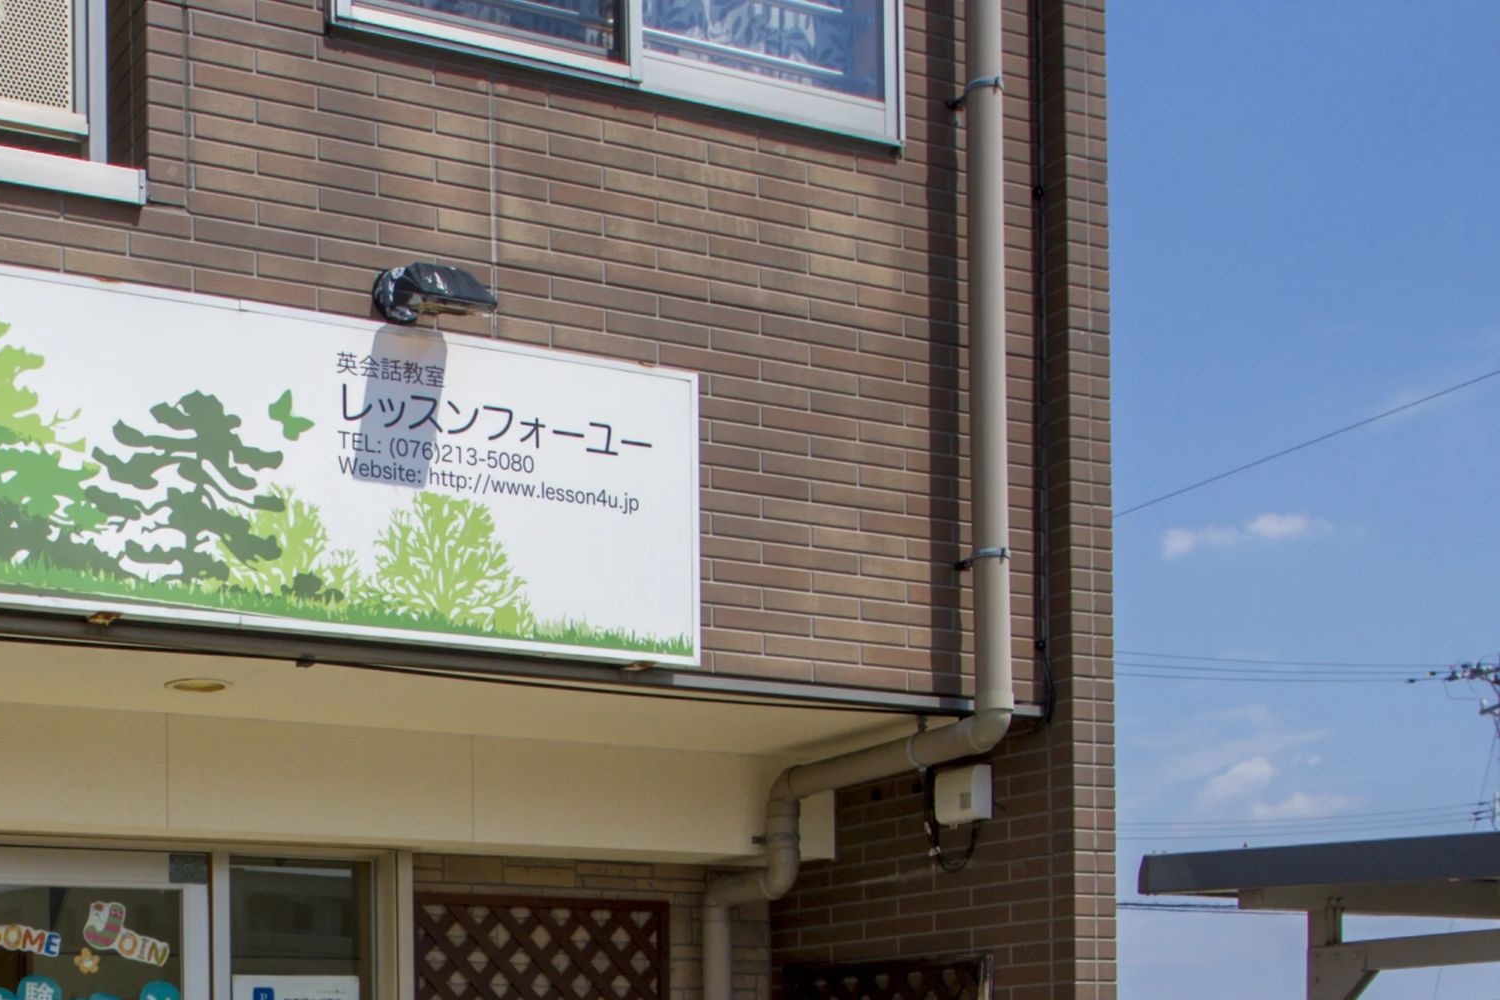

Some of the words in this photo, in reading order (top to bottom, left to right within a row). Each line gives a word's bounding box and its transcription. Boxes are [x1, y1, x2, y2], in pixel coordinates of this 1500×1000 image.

[336, 351, 445, 388] 英会話教室
[342, 383, 653, 457] レッスンフォーユー
[338, 431, 381, 454] TEL:
[389, 436, 535, 475] (076)213-5080
[338, 456, 422, 485] Website:
[429, 466, 640, 515] http://www.lesson4u.jp
[83, 902, 170, 966] JOIN
